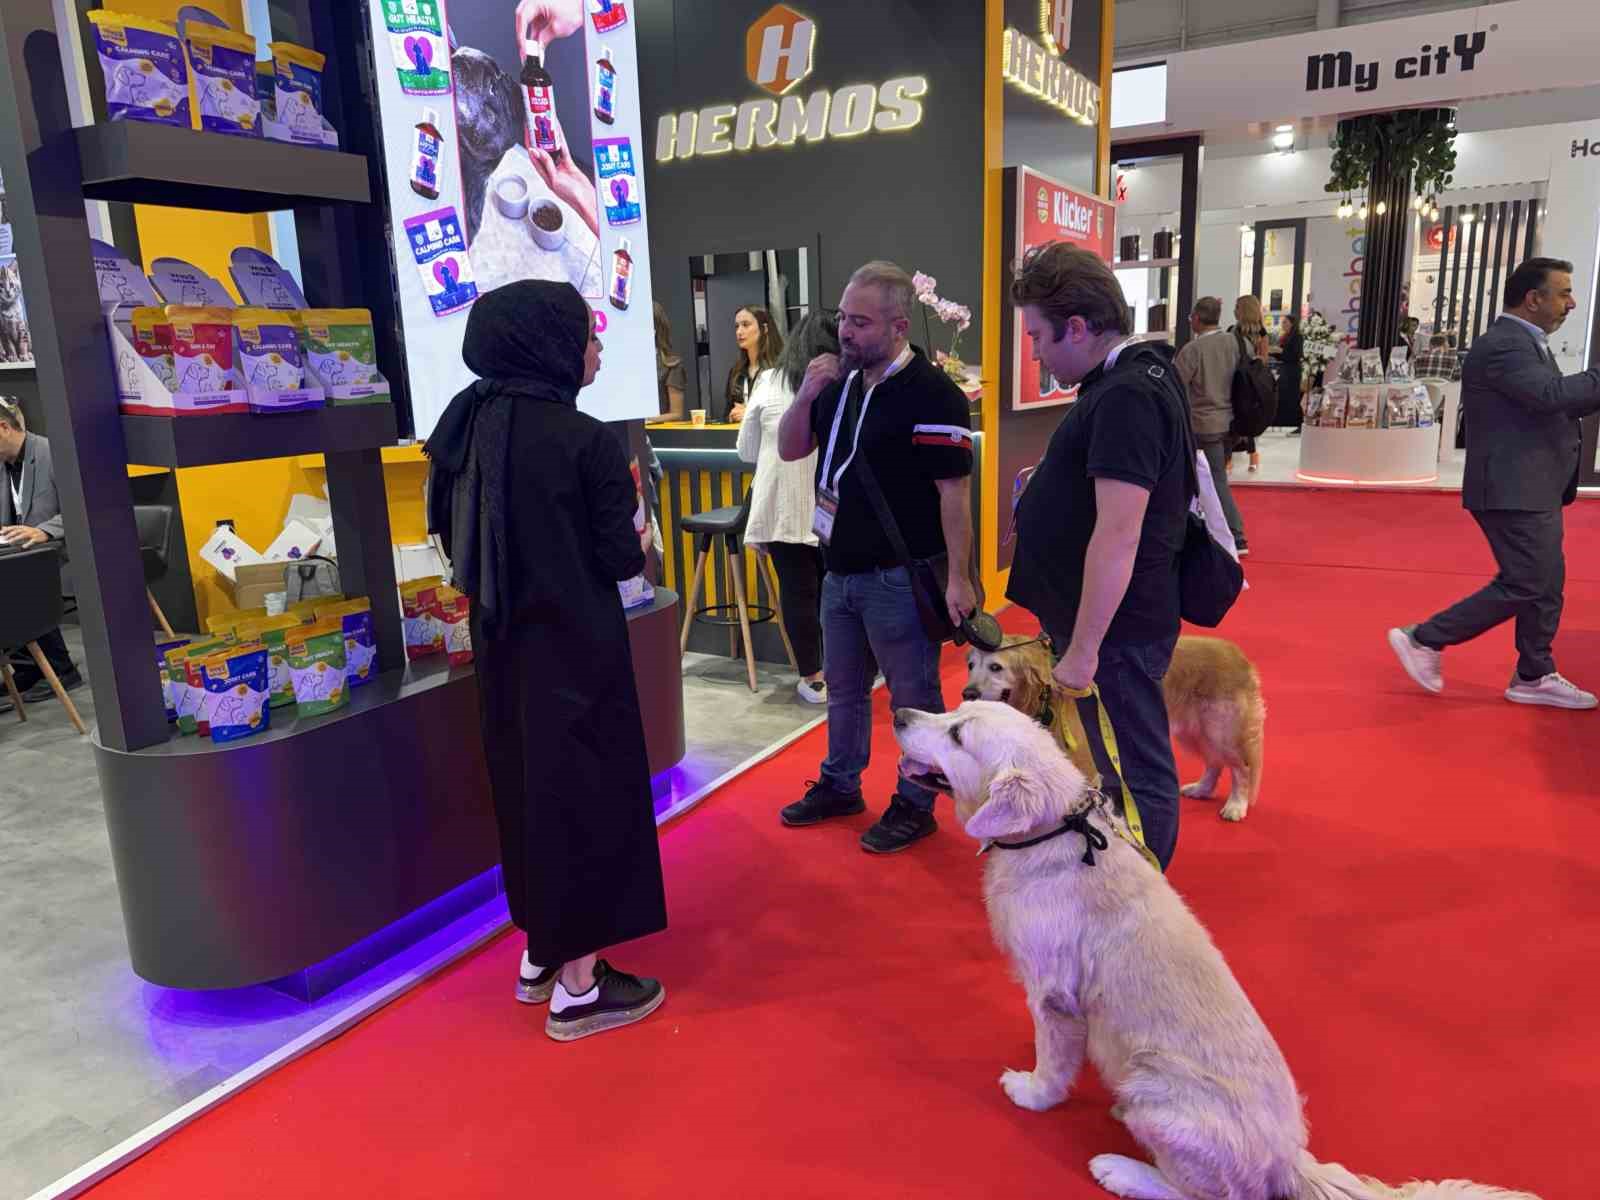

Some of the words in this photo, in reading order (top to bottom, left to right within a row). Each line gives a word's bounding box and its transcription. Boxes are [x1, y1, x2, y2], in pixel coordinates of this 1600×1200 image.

[756, 20, 815, 84] H
[1003, 28, 1101, 126] HERMOS
[1306, 51, 1379, 92] My
[656, 76, 928, 162] HERMOS
[1053, 191, 1093, 236] Klicker
